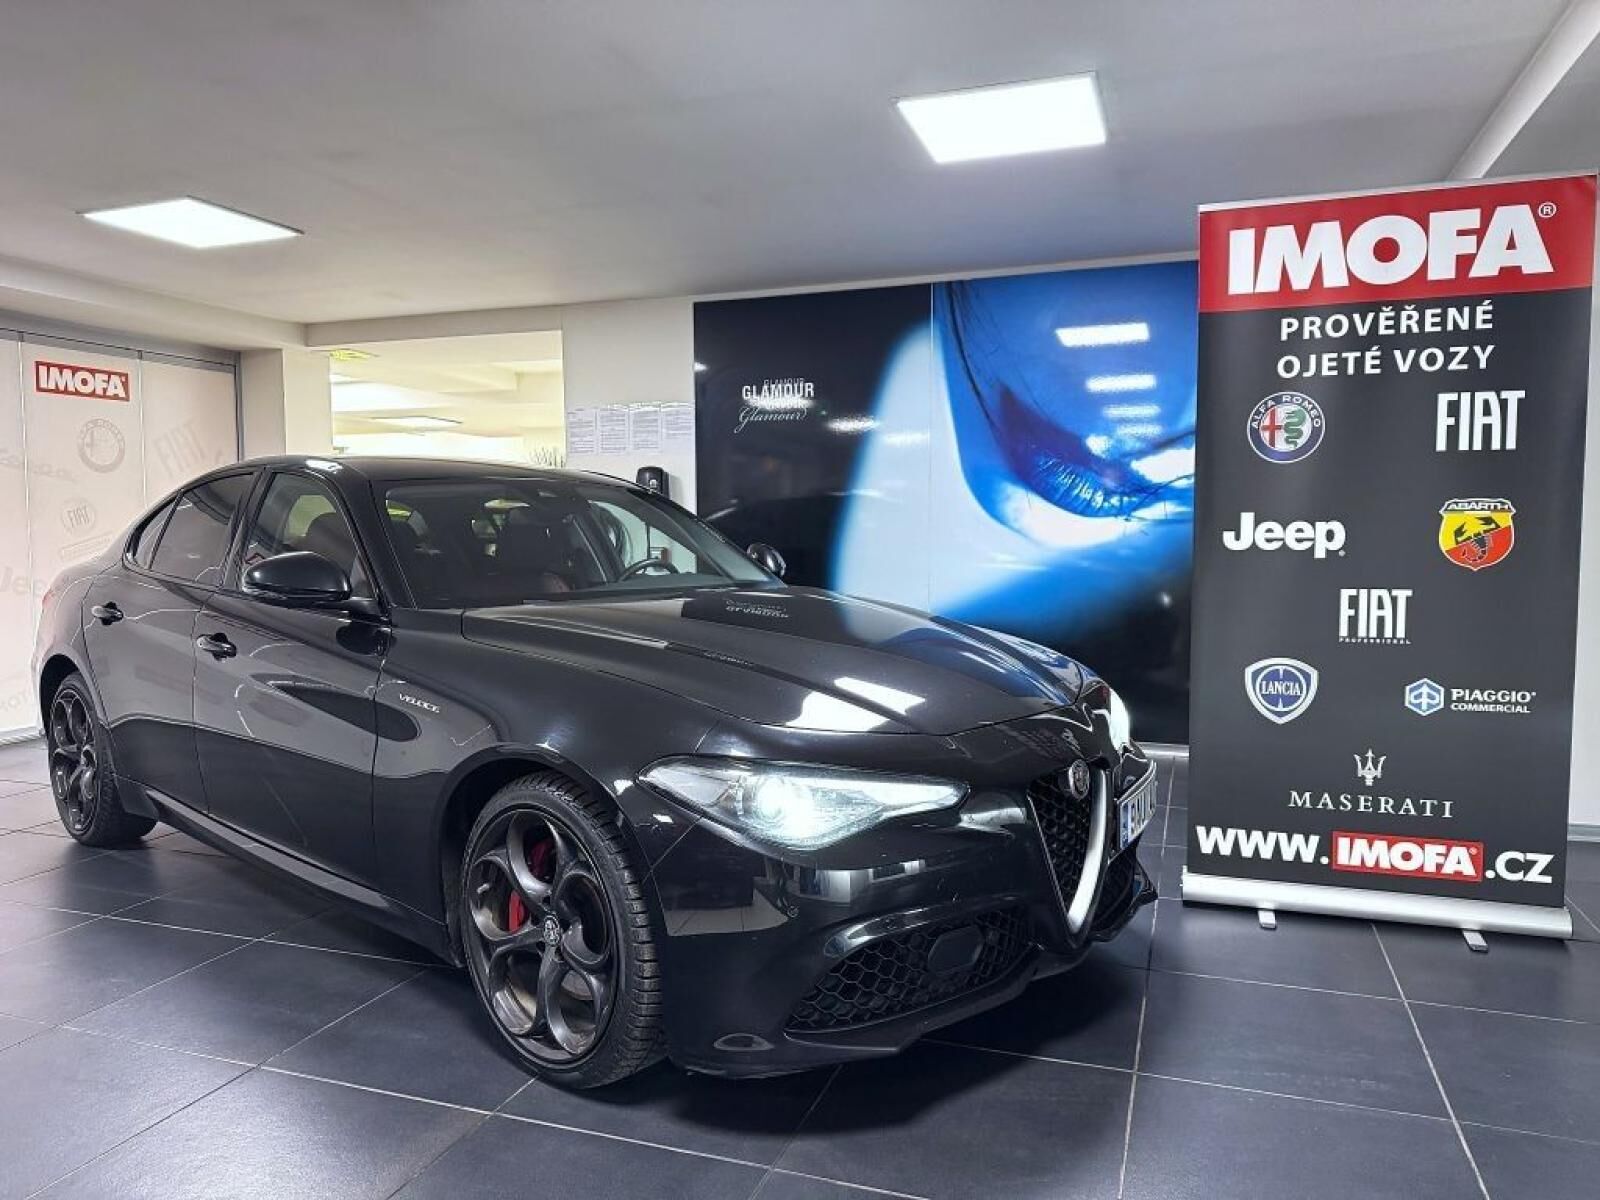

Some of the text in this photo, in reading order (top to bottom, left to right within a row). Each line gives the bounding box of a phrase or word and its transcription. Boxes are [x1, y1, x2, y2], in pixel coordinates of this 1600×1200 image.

[1280, 300, 1494, 342] PROVĚŘENÉ
[1277, 345, 1496, 379] OJETÉ VOZY
[38, 365, 127, 397] IMOFA
[742, 382, 815, 401] GLAMOUR
[1435, 390, 1526, 452] FIAT
[1447, 502, 1509, 511] ABARTH
[1222, 512, 1346, 559] Jeep
[1339, 588, 1413, 639] FIAT
[1261, 680, 1302, 696] LANCIA
[1450, 688, 1531, 703] PIAGGIO
[1450, 702, 1531, 713] COMMERCIAL
[1288, 790, 1454, 818] MASERATI
